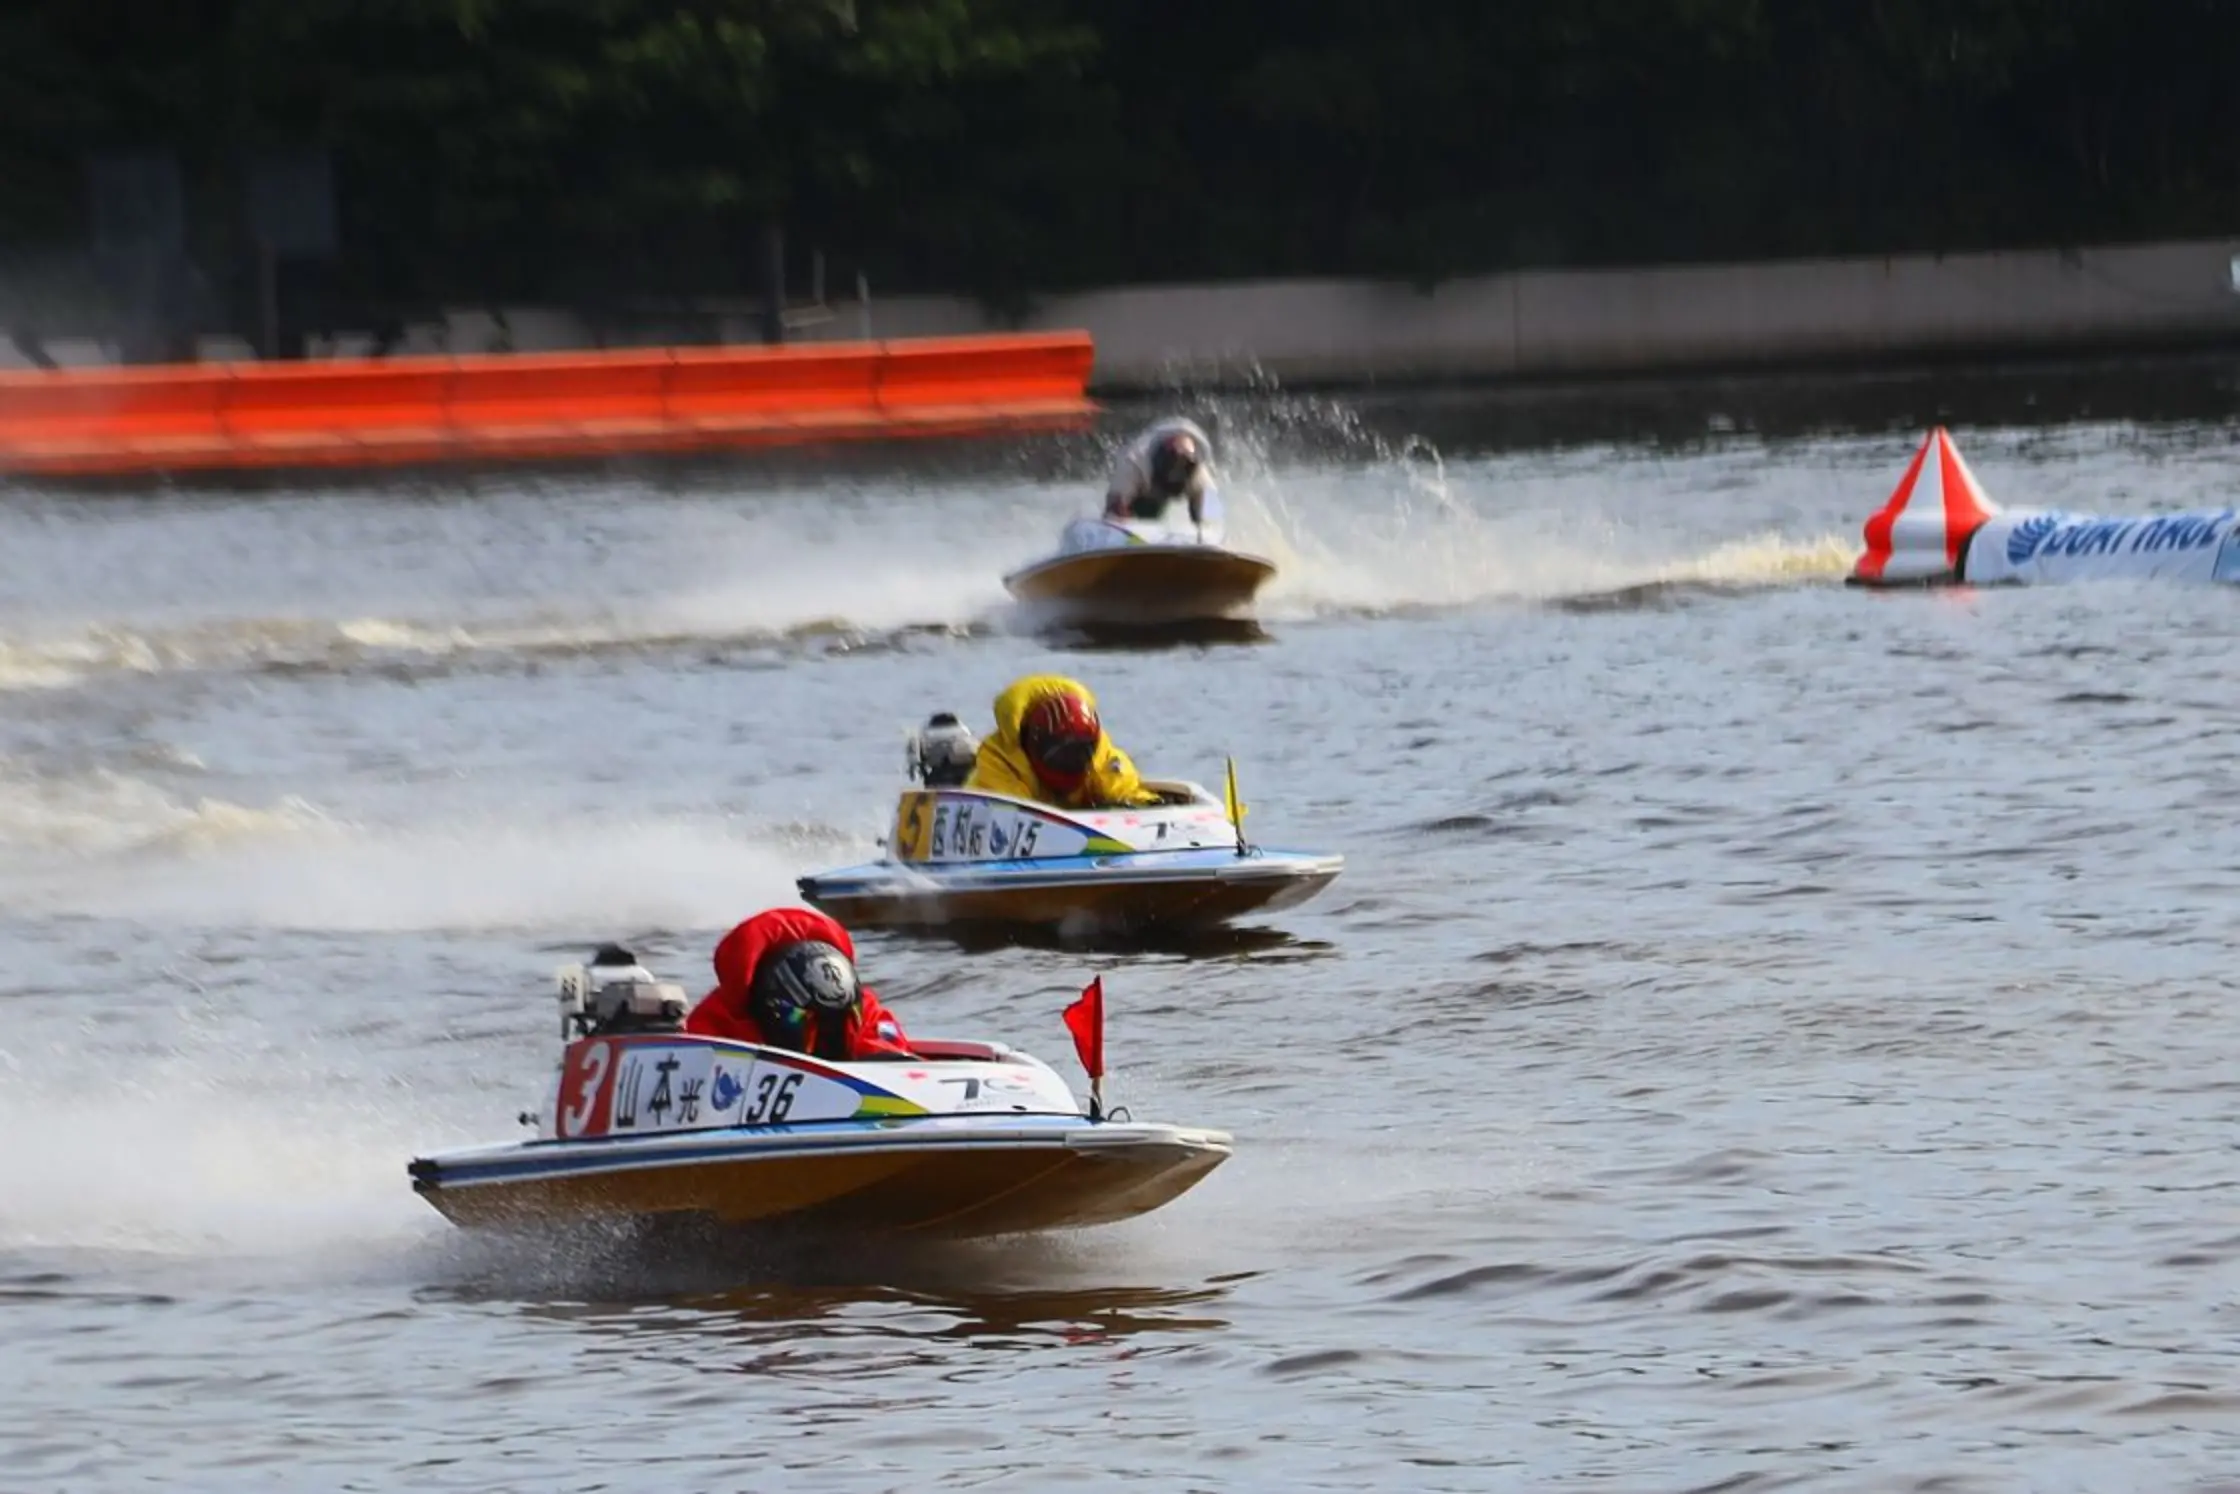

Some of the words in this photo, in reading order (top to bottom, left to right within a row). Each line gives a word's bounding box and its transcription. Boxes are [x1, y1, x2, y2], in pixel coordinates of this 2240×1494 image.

[901, 792, 929, 858] 5
[1011, 820, 1044, 858] 15
[563, 1041, 611, 1136] 3
[616, 1053, 704, 1128] 山本光
[746, 1073, 804, 1123] 36
